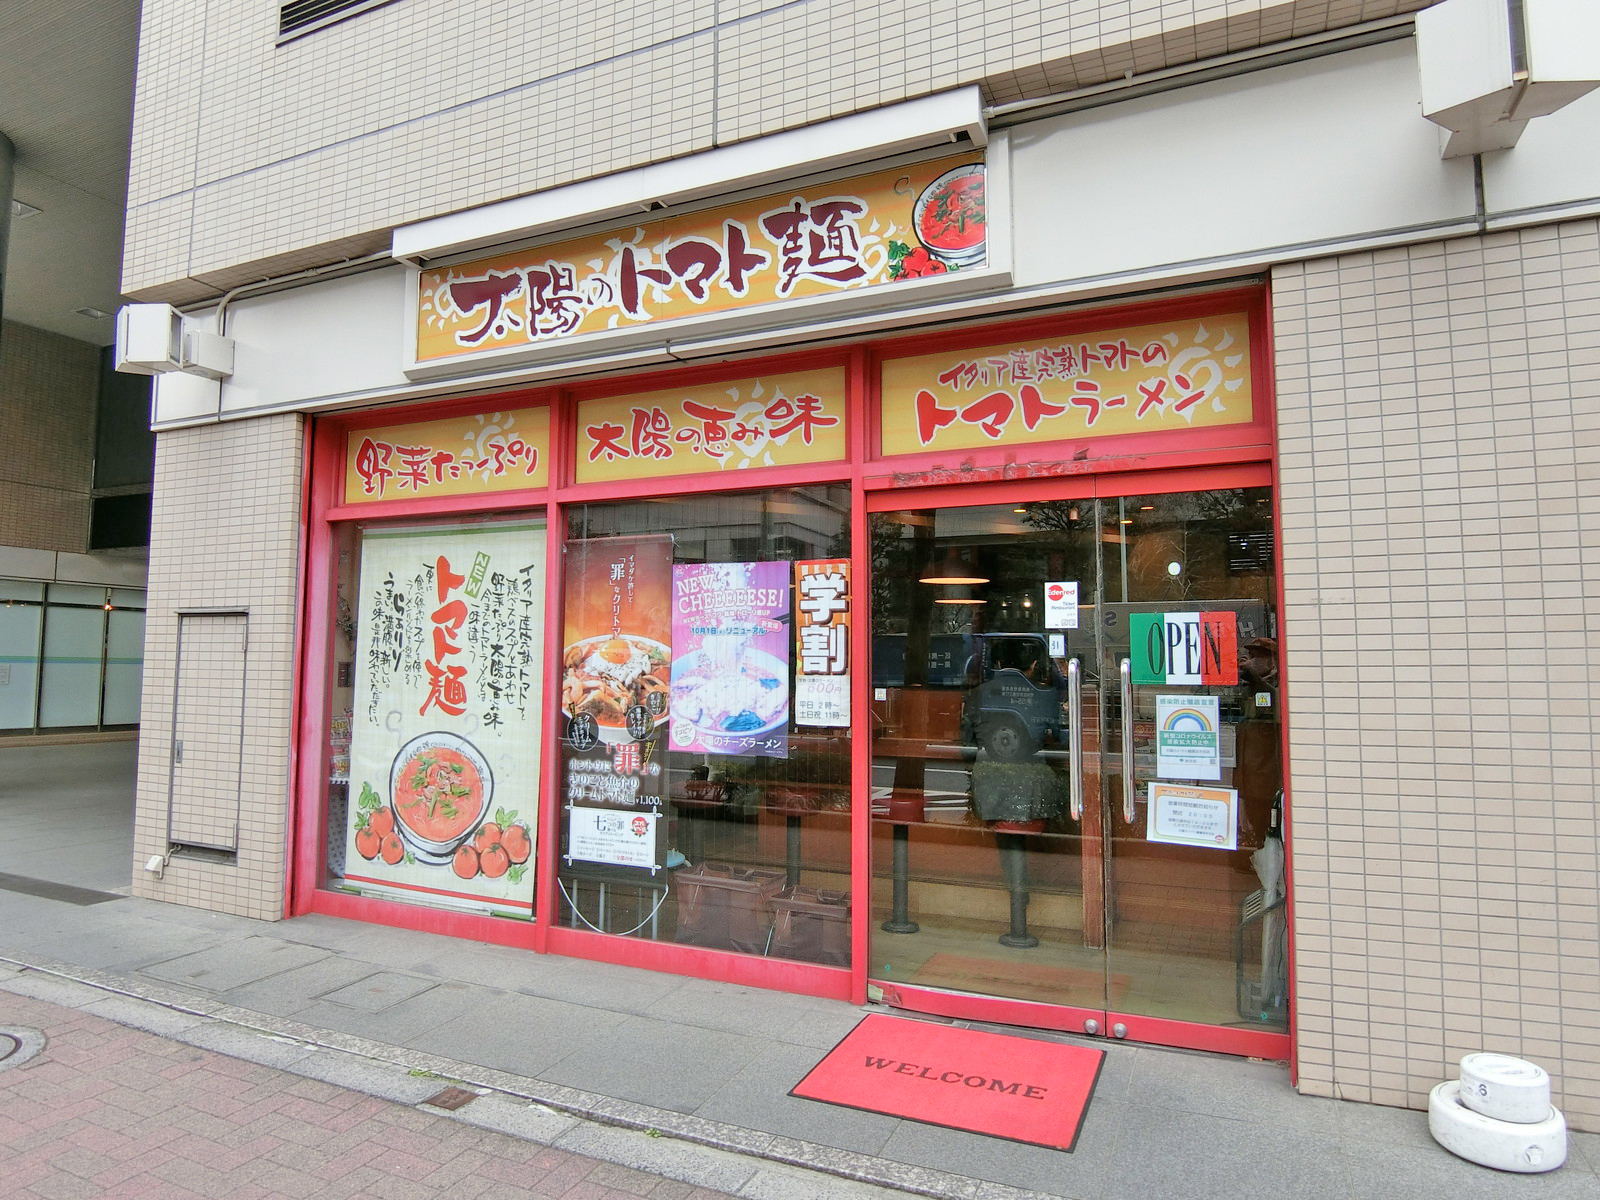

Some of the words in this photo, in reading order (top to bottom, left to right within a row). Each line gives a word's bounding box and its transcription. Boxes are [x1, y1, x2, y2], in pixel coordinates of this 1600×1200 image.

[448, 201, 864, 342] 太陽のトマト麺
[939, 340, 1167, 390] イタリア産完熟トマトの
[587, 396, 839, 462] 太陽の恵み味
[915, 374, 1206, 445] トマトラーメン
[355, 434, 540, 498] 野菜たっぷり
[466, 552, 489, 597] NEW
[676, 573, 716, 596] NEW
[678, 588, 784, 614] CHEEEEESE!
[800, 572, 849, 675] 学割
[419, 555, 469, 716] トマト麺
[1147, 621, 1222, 676] OPEN
[799, 700, 814, 709] 平日
[799, 710, 821, 719] 土日祝
[863, 1055, 1048, 1101] WELCOME
